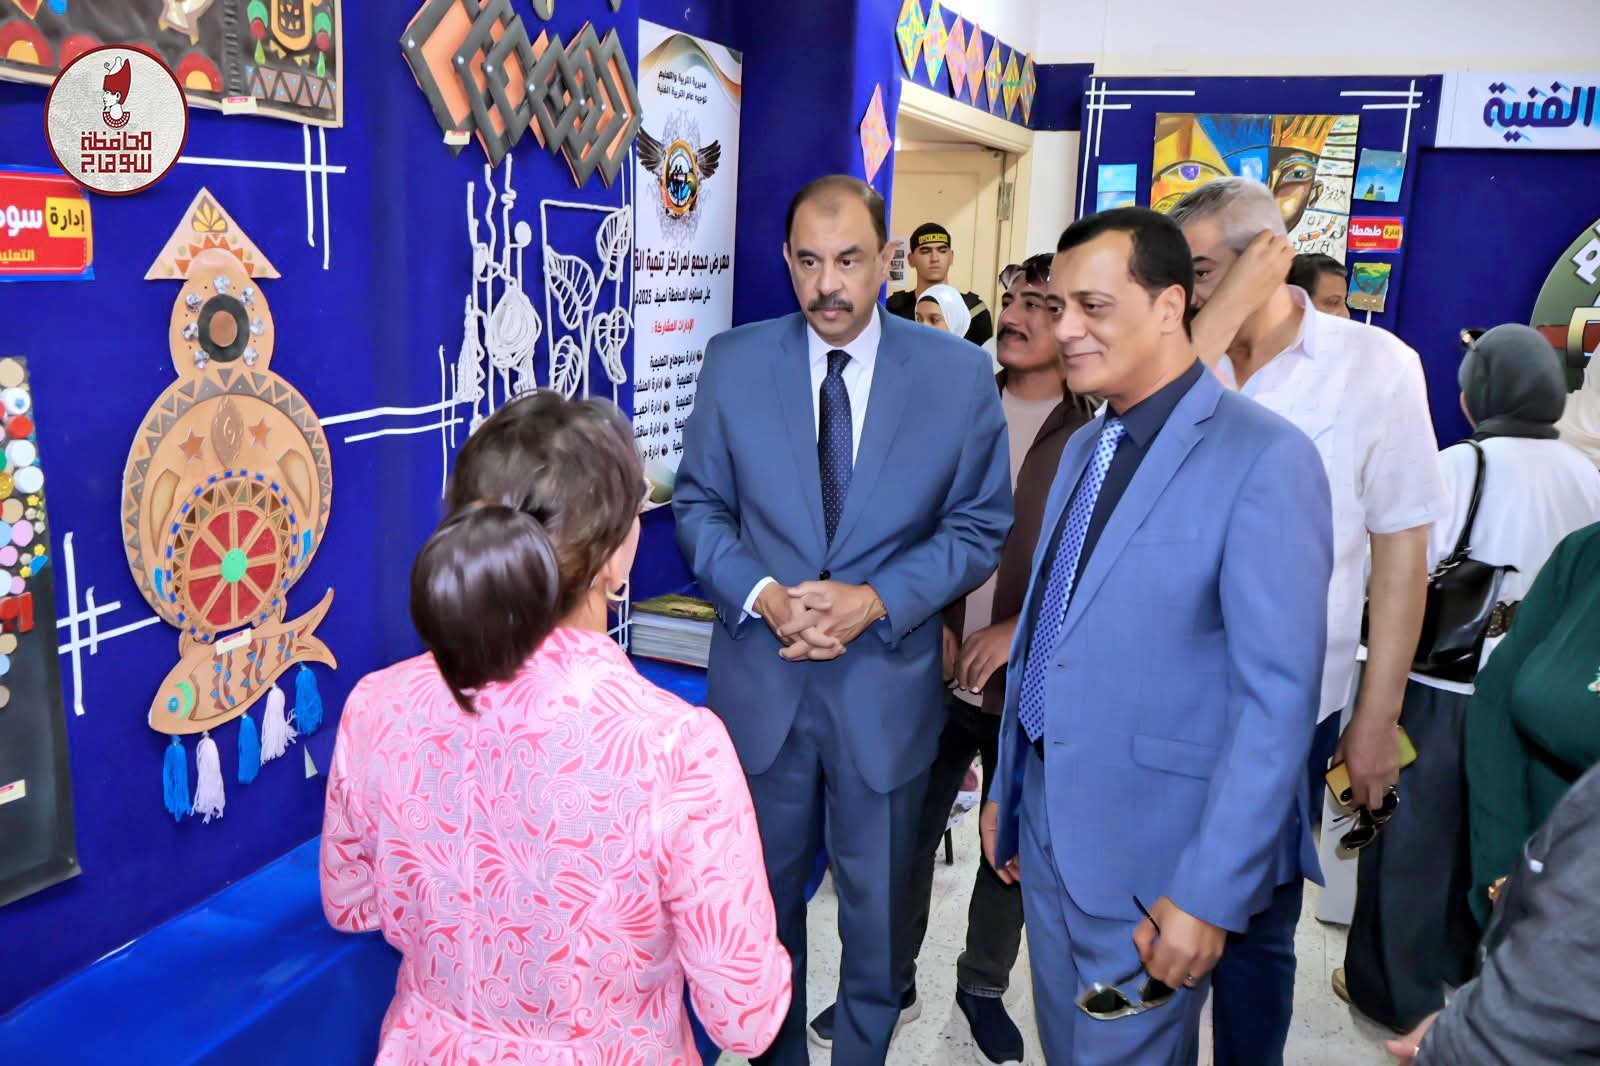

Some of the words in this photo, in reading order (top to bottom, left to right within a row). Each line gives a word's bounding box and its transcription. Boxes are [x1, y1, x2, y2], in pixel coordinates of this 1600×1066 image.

[659, 70, 677, 82] والتعليم
[678, 73, 691, 85] التربية
[672, 86, 685, 99] التربية
[1483, 81, 1597, 143] الفنية
[50, 206, 85, 232] إدارة
[0, 248, 35, 264] التعلي
[647, 248, 665, 277] تنمية
[666, 250, 690, 277] لمراكز
[710, 253, 730, 275] معرض
[691, 254, 708, 277] مجمع
[654, 287, 667, 307] لصيف
[669, 286, 688, 302] المحافظة
[689, 287, 702, 304] مستوى
[703, 286, 711, 304] على
[650, 355, 668, 372] التعليمية
[669, 354, 685, 369] سوهاج
[686, 350, 697, 365] إدارة
[652, 377, 663, 392] إدارة
[677, 373, 694, 389] التعليمية
[650, 400, 661, 415] إدارة
[649, 422, 660, 437] إدارة
[648, 444, 660, 460] إدارة
